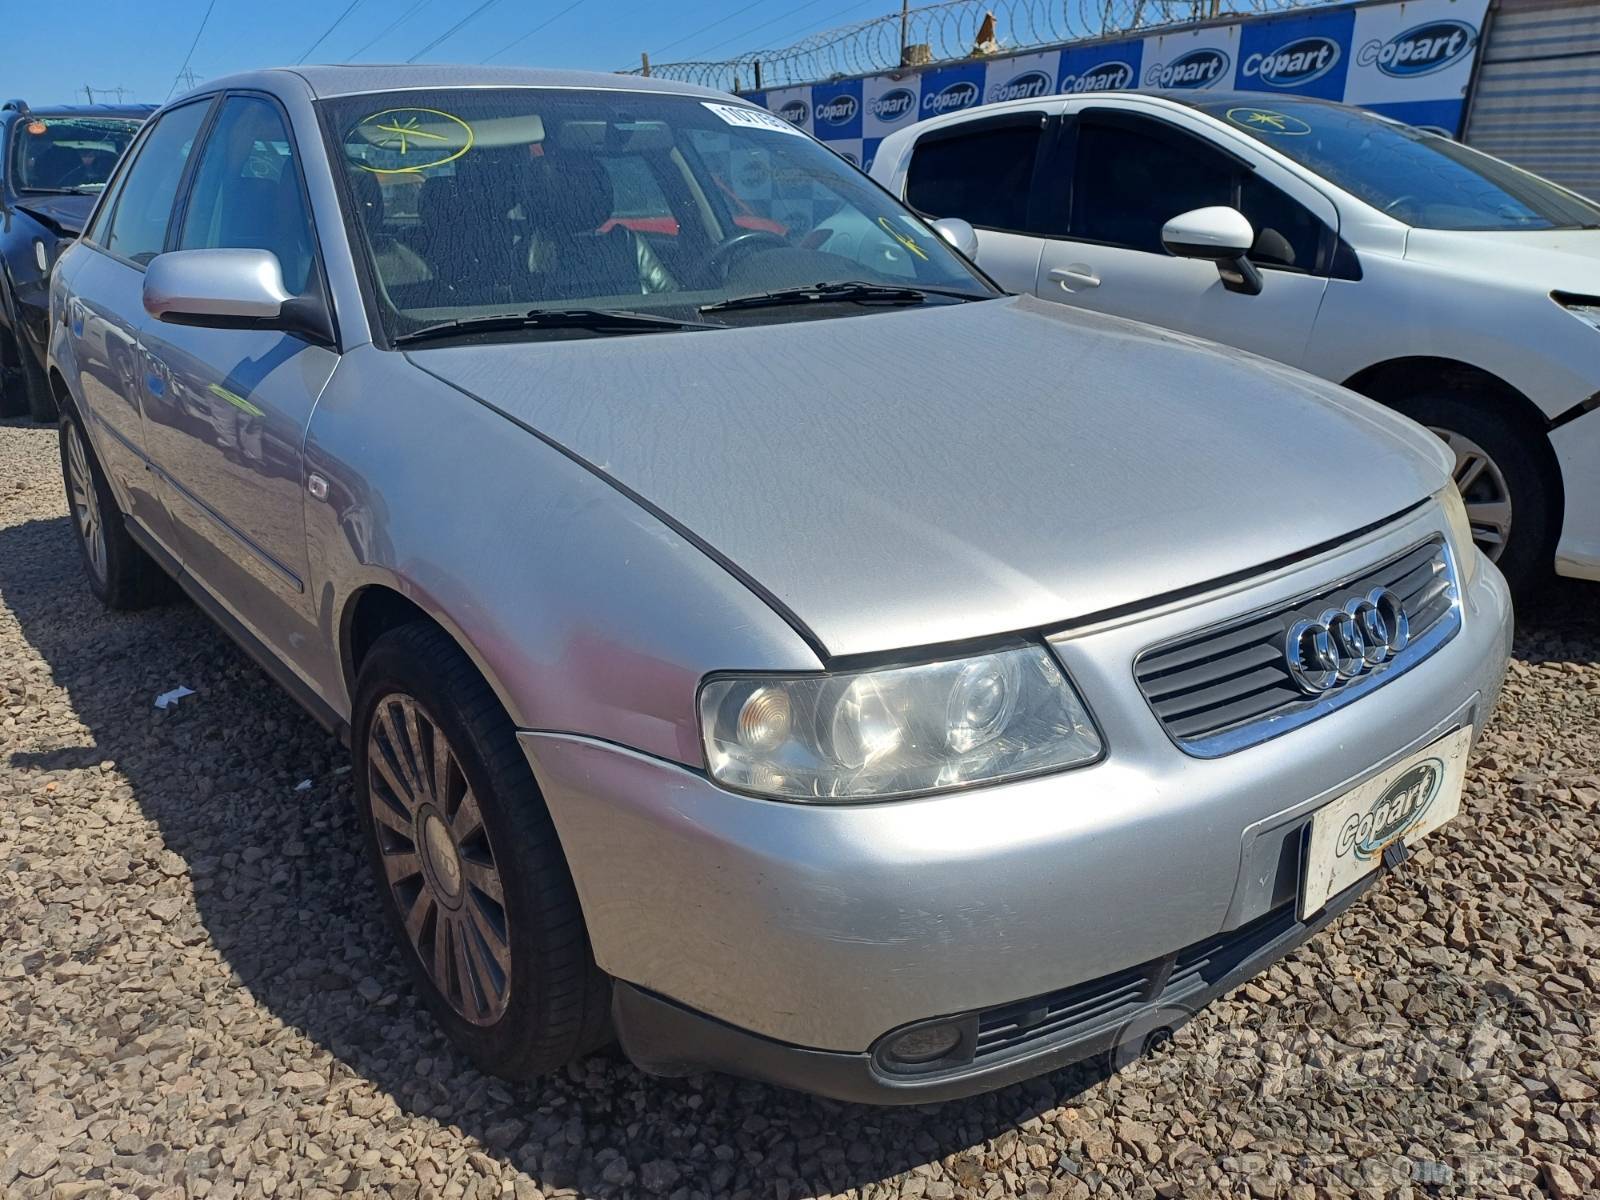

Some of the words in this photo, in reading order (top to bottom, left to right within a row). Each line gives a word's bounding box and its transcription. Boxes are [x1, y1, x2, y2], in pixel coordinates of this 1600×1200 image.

[1357, 29, 1463, 68] Copart
[1144, 56, 1220, 87] Copart
[1242, 45, 1329, 79] Copart
[986, 78, 1044, 103] Copart
[1060, 68, 1126, 94] Copart
[814, 100, 854, 120] Copart
[865, 95, 910, 117] Copart
[922, 87, 973, 112] Copart
[774, 105, 806, 121] part
[1335, 766, 1432, 858] Copart
